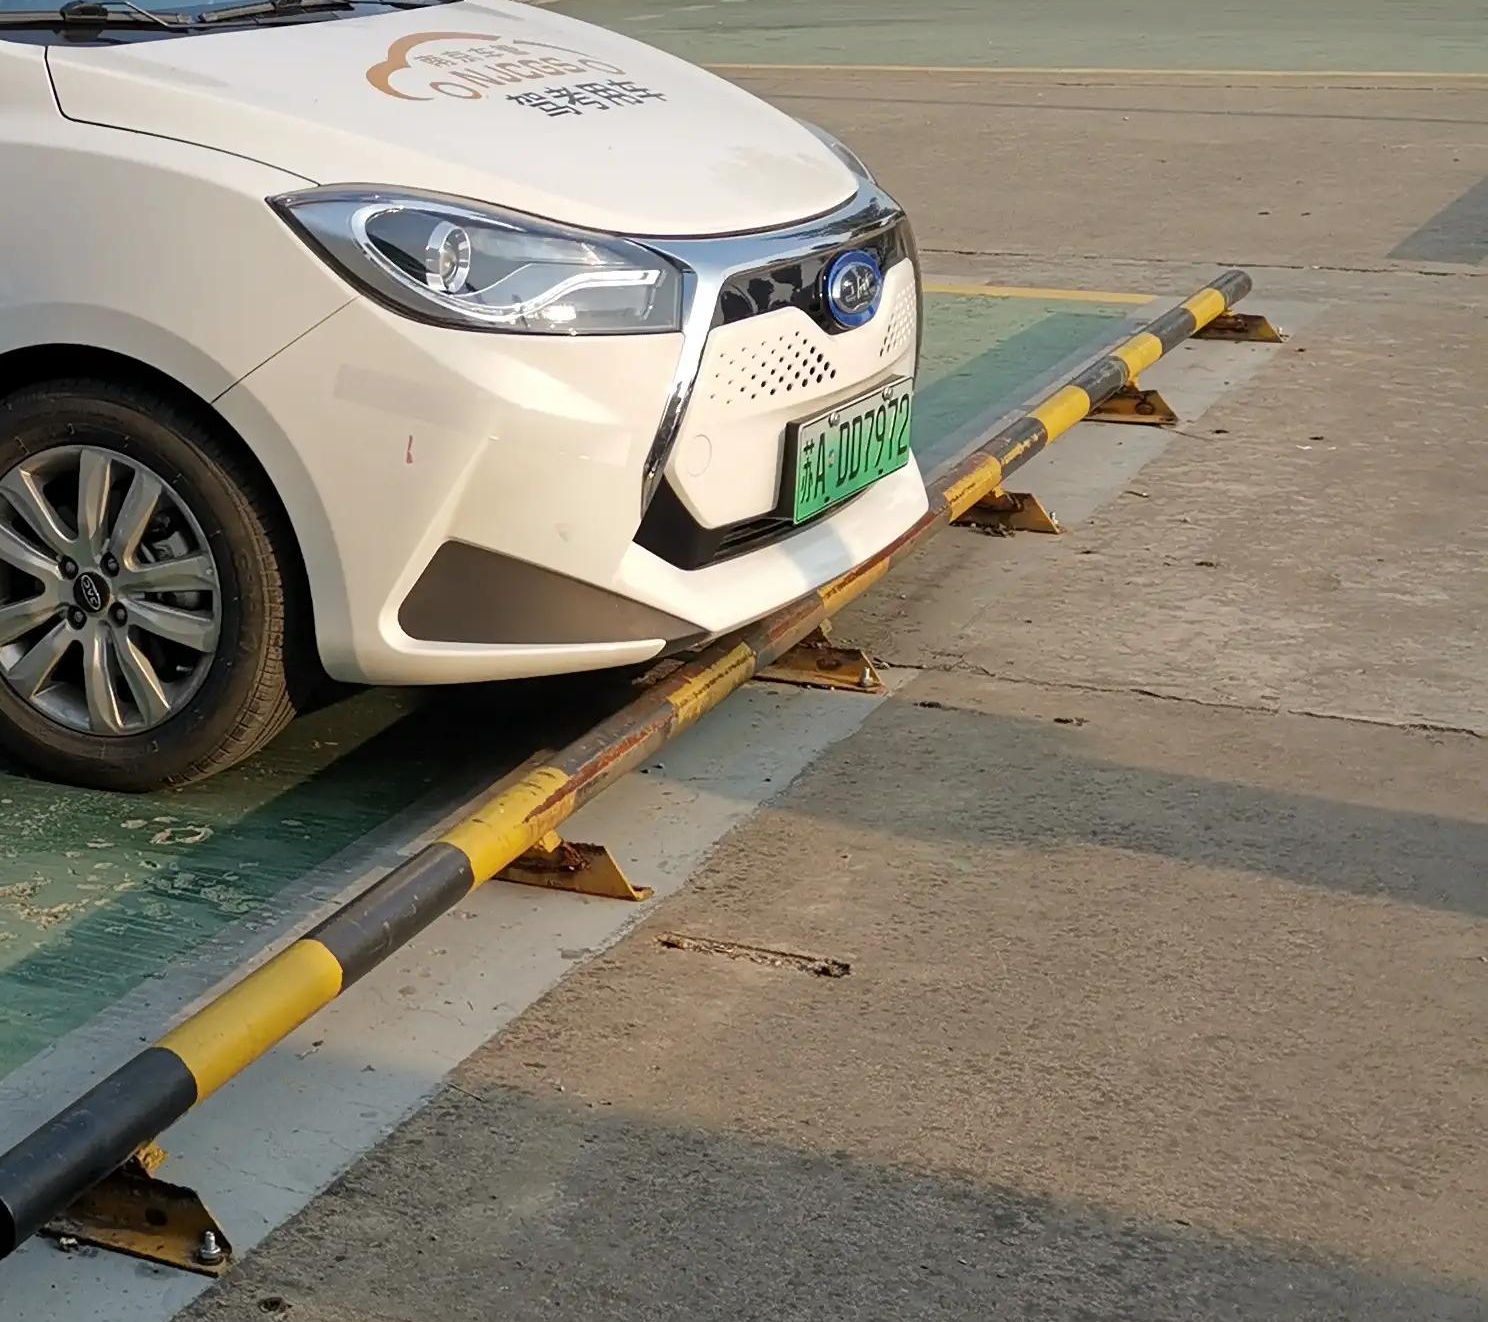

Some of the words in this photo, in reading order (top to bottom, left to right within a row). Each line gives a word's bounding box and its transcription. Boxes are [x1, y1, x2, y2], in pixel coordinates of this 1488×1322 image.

[448, 57, 586, 88] NJCGS
[506, 79, 667, 117] 驾考用车
